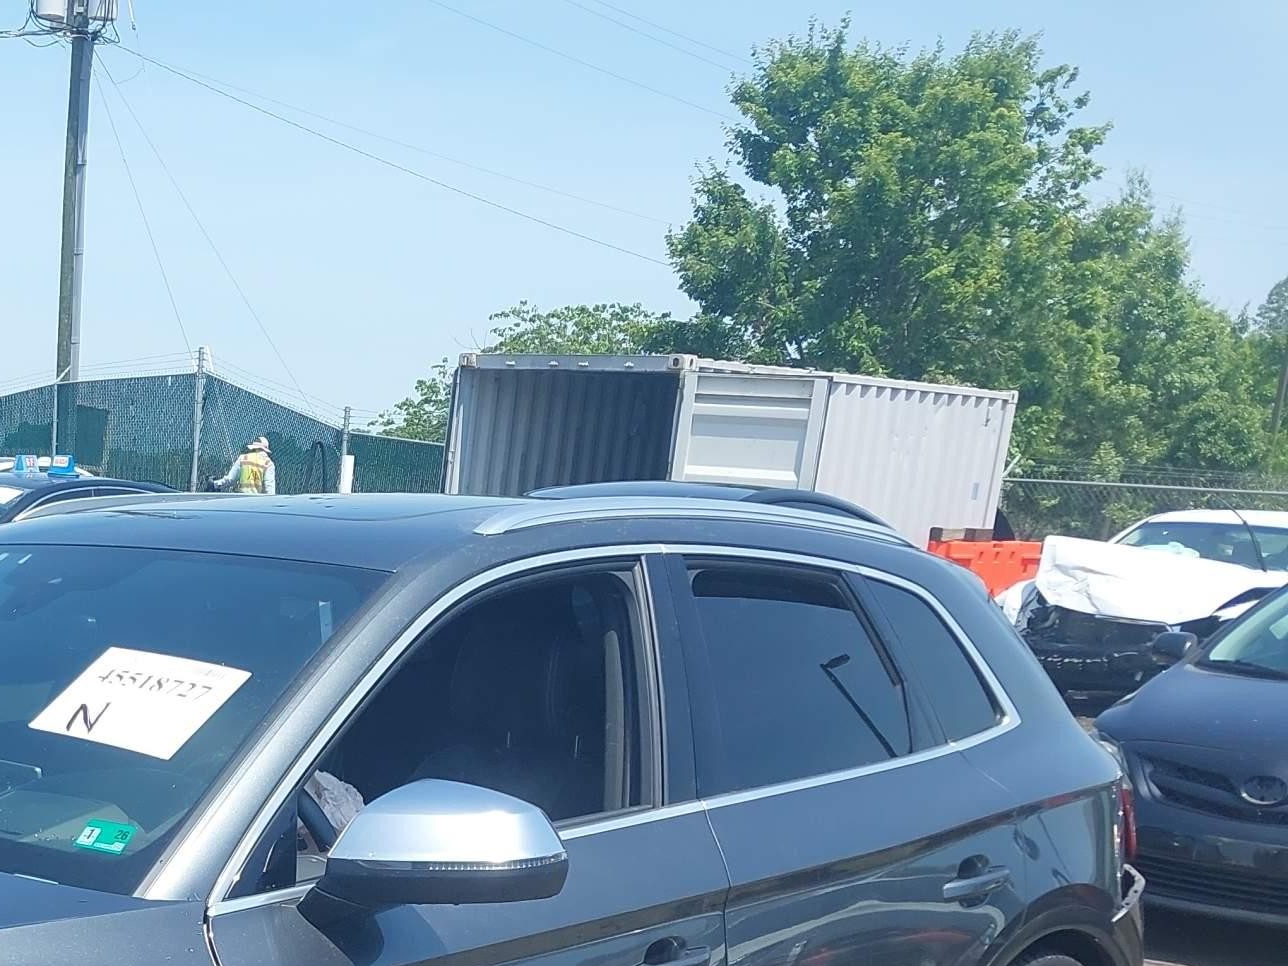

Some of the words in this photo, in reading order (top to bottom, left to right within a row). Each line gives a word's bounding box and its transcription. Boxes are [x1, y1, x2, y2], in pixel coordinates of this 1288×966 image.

[98, 668, 213, 701] 45518727
[65, 701, 112, 735] N
[114, 829, 130, 841] 26
